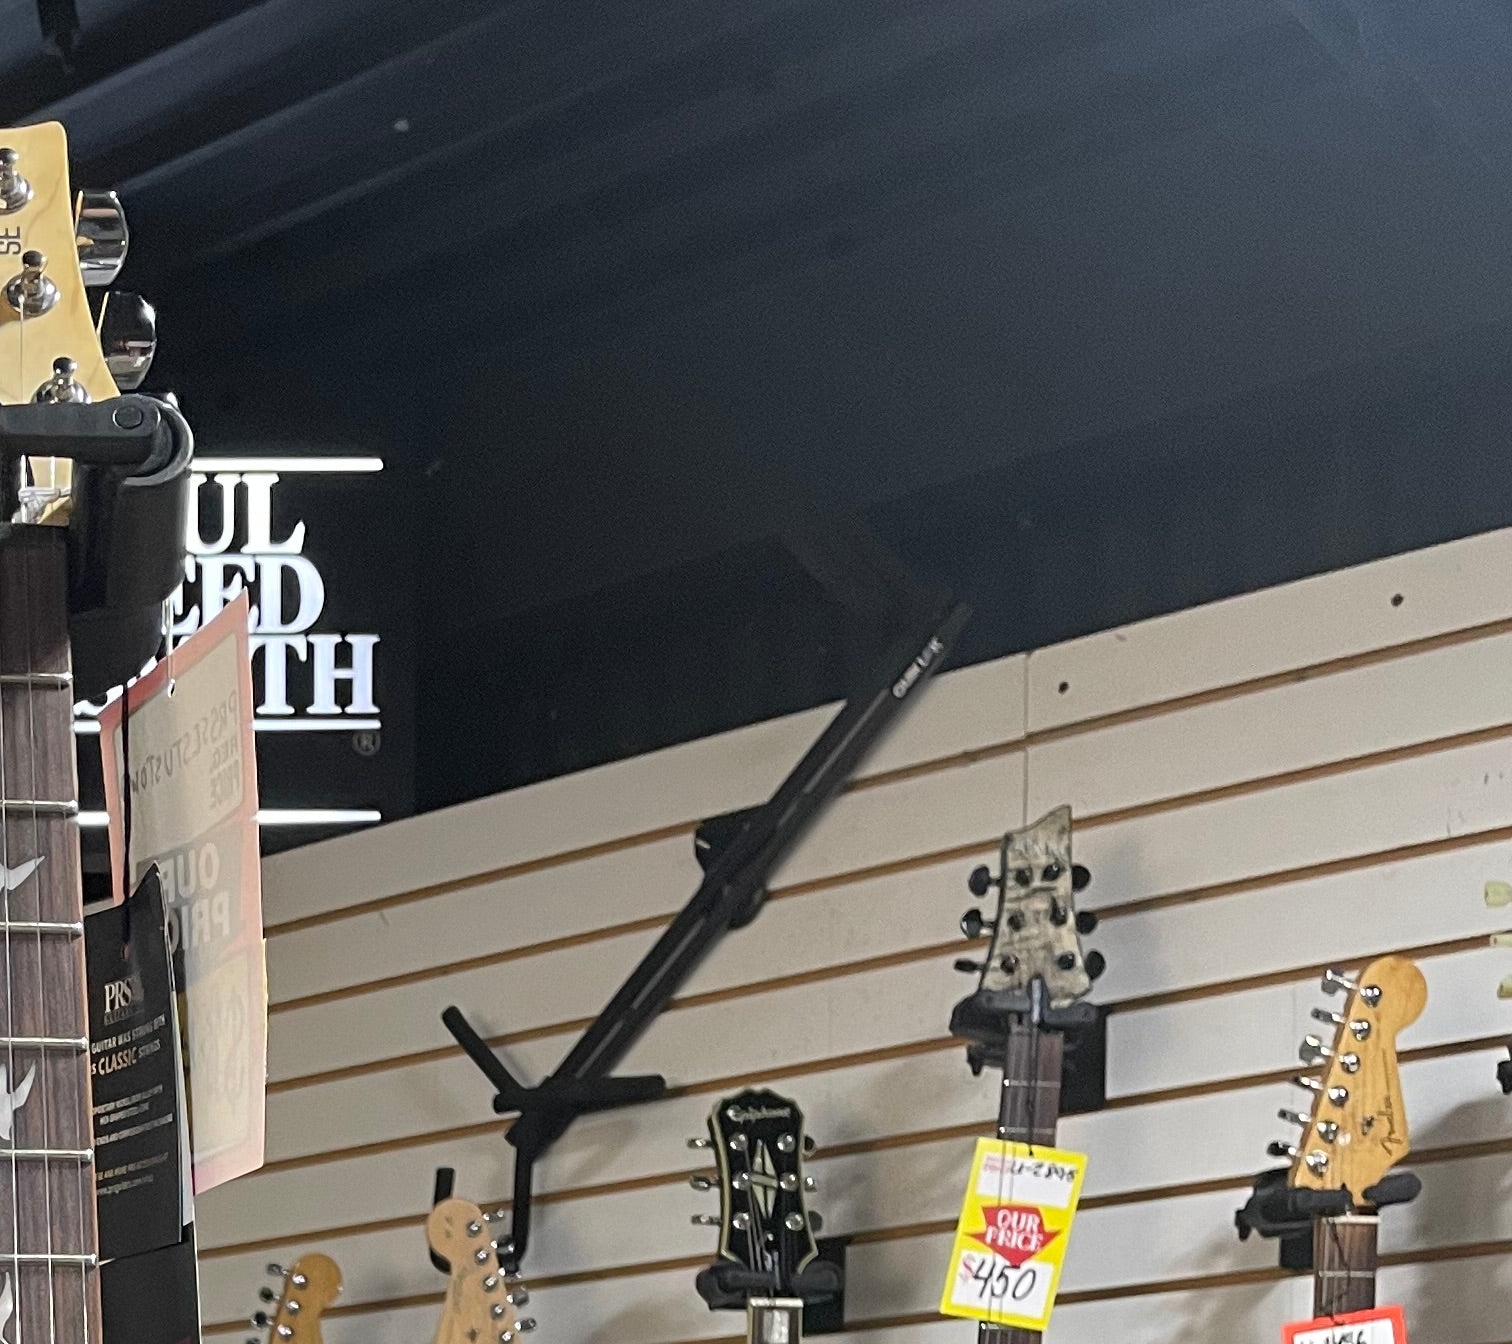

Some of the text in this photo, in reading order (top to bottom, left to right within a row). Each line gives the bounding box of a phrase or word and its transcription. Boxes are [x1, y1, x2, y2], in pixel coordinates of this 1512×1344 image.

[185, 473, 306, 554] UL
[98, 1047, 137, 1076] CLASSIC
[997, 1209, 1041, 1232] OUR
[985, 1225, 1044, 1252] PRICE
